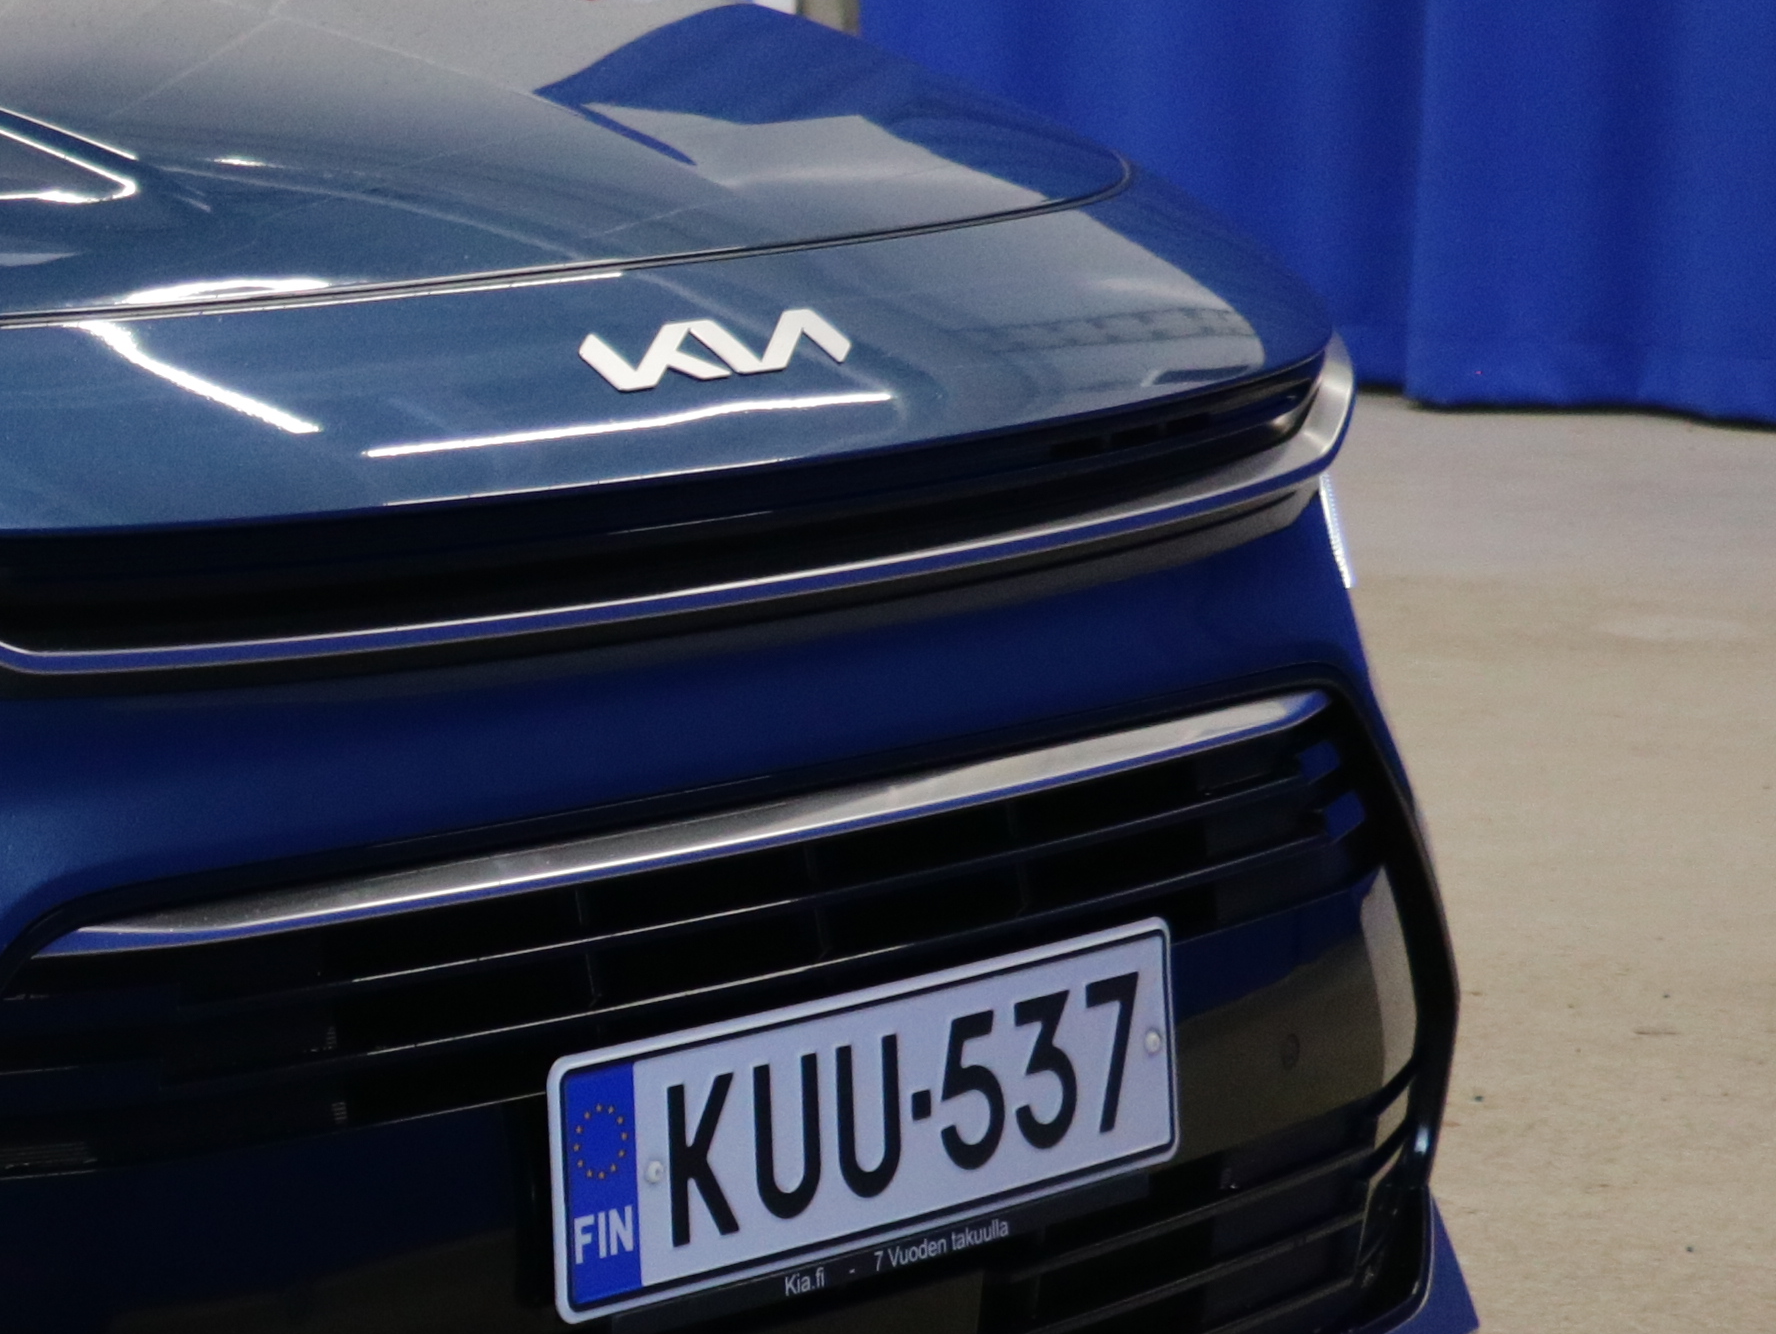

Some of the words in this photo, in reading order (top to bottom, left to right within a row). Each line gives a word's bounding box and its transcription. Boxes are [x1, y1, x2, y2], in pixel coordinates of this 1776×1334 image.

[577, 307, 852, 393] KIA
[665, 970, 1140, 1249] KUU-537
[573, 1204, 635, 1265] FIN
[783, 1267, 825, 1297] Kia.fi
[873, 1251, 884, 1272] 7
[886, 1235, 948, 1268] Vuoden
[951, 1218, 1010, 1253] takuulla
